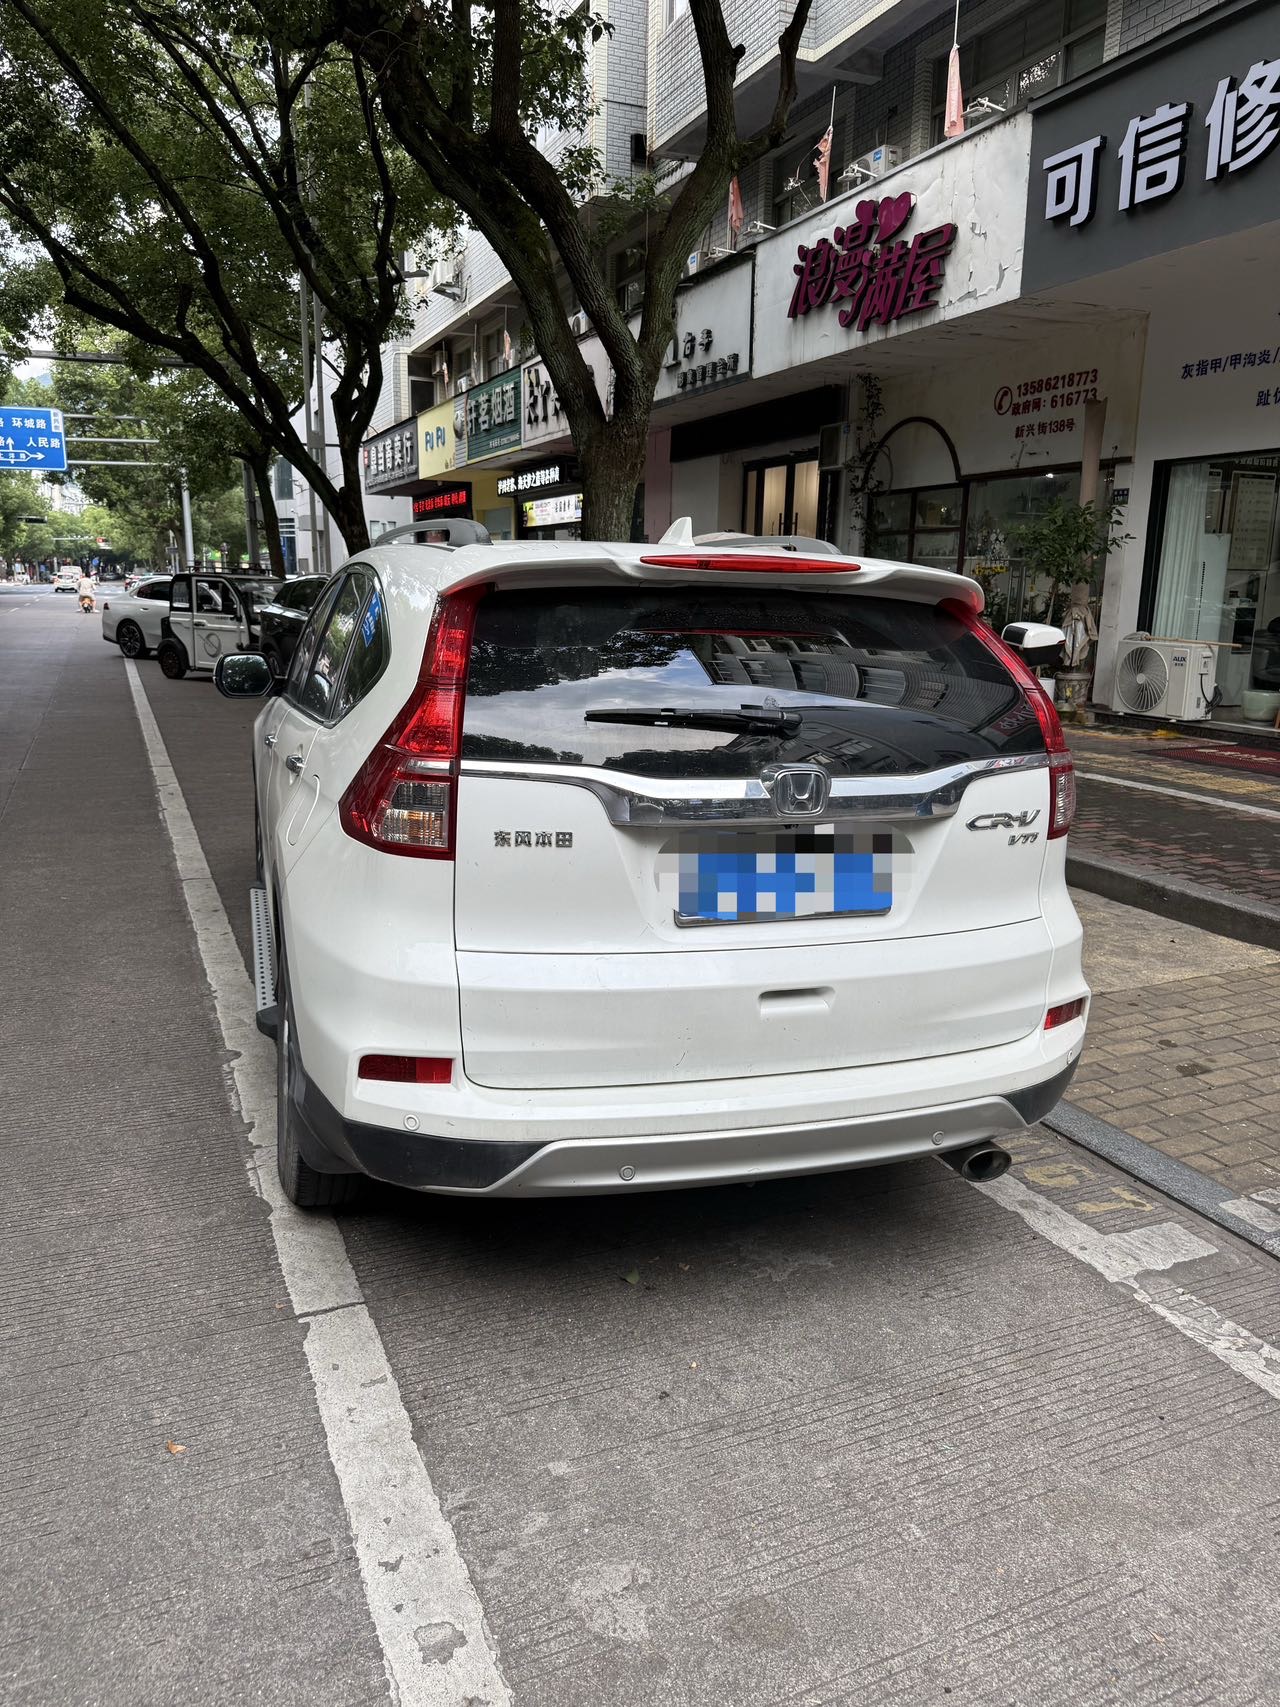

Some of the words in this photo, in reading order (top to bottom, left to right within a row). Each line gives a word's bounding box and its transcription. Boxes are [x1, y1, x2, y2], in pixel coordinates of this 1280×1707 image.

[1042, 58, 1280, 227] 可信修
[787, 192, 958, 332] 浪漫满屋
[1181, 347, 1280, 379] 灰指甲/甲沟炎/
[1016, 368, 1098, 398] 13586218773
[12, 417, 47, 430] 环城路
[26, 436, 61, 449] 人民路
[966, 809, 1041, 831] CR-V
[493, 830, 573, 848] 东风本田
